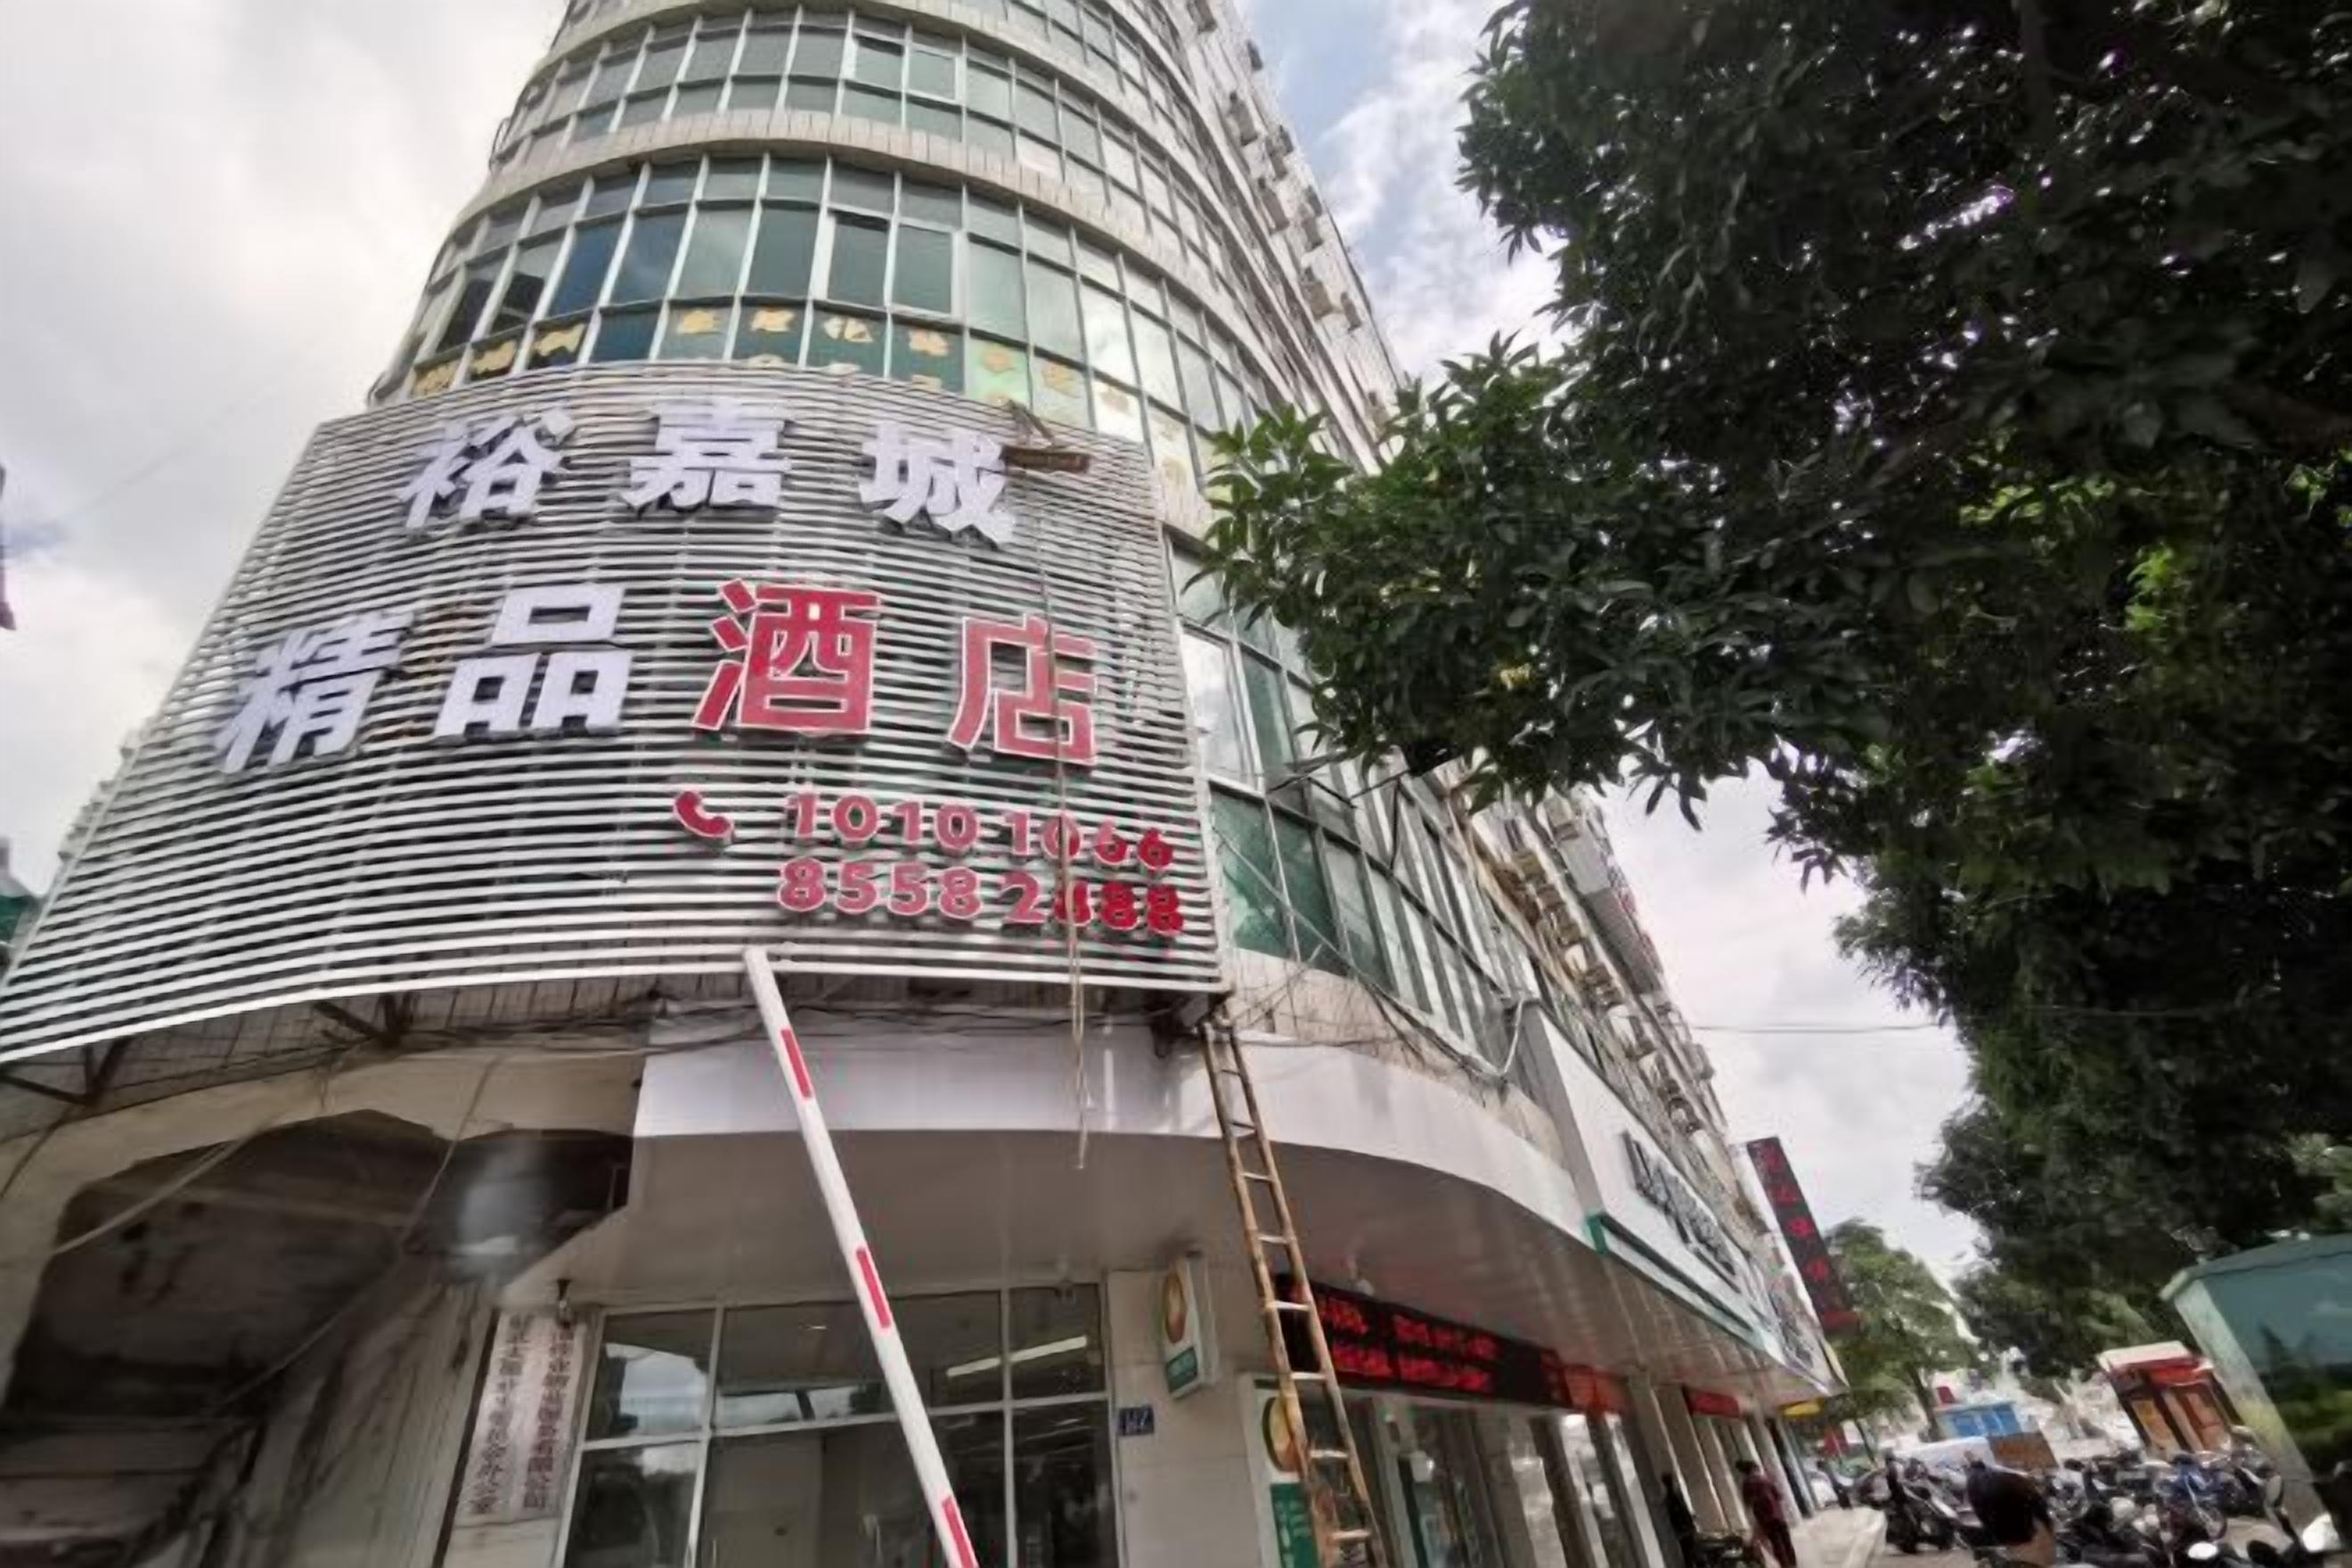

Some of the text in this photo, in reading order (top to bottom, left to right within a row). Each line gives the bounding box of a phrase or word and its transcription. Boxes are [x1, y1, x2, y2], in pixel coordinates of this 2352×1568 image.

[398, 399, 1017, 543] 裕嘉城
[213, 577, 1098, 772] 精品酒店
